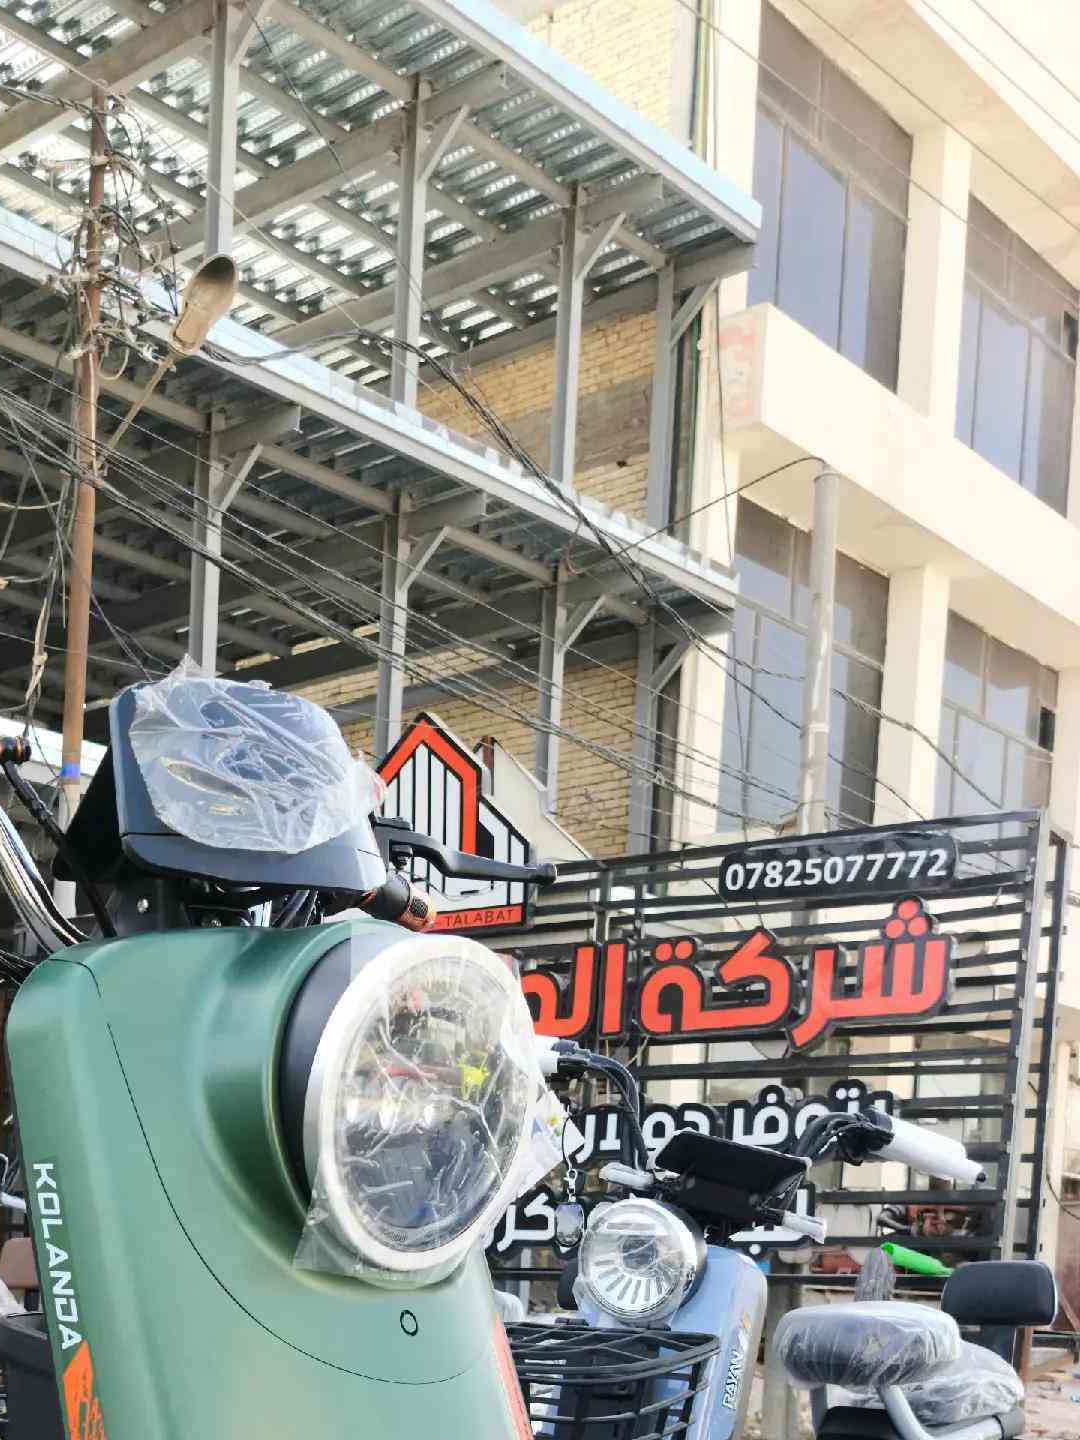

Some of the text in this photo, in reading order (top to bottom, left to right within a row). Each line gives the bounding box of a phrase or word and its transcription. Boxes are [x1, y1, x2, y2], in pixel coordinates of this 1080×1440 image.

[443, 908, 515, 927] TALABAT
[725, 849, 948, 891] 07825077772
[639, 899, 947, 1049] شركة
[32, 1162, 84, 1351] KOLANDA
